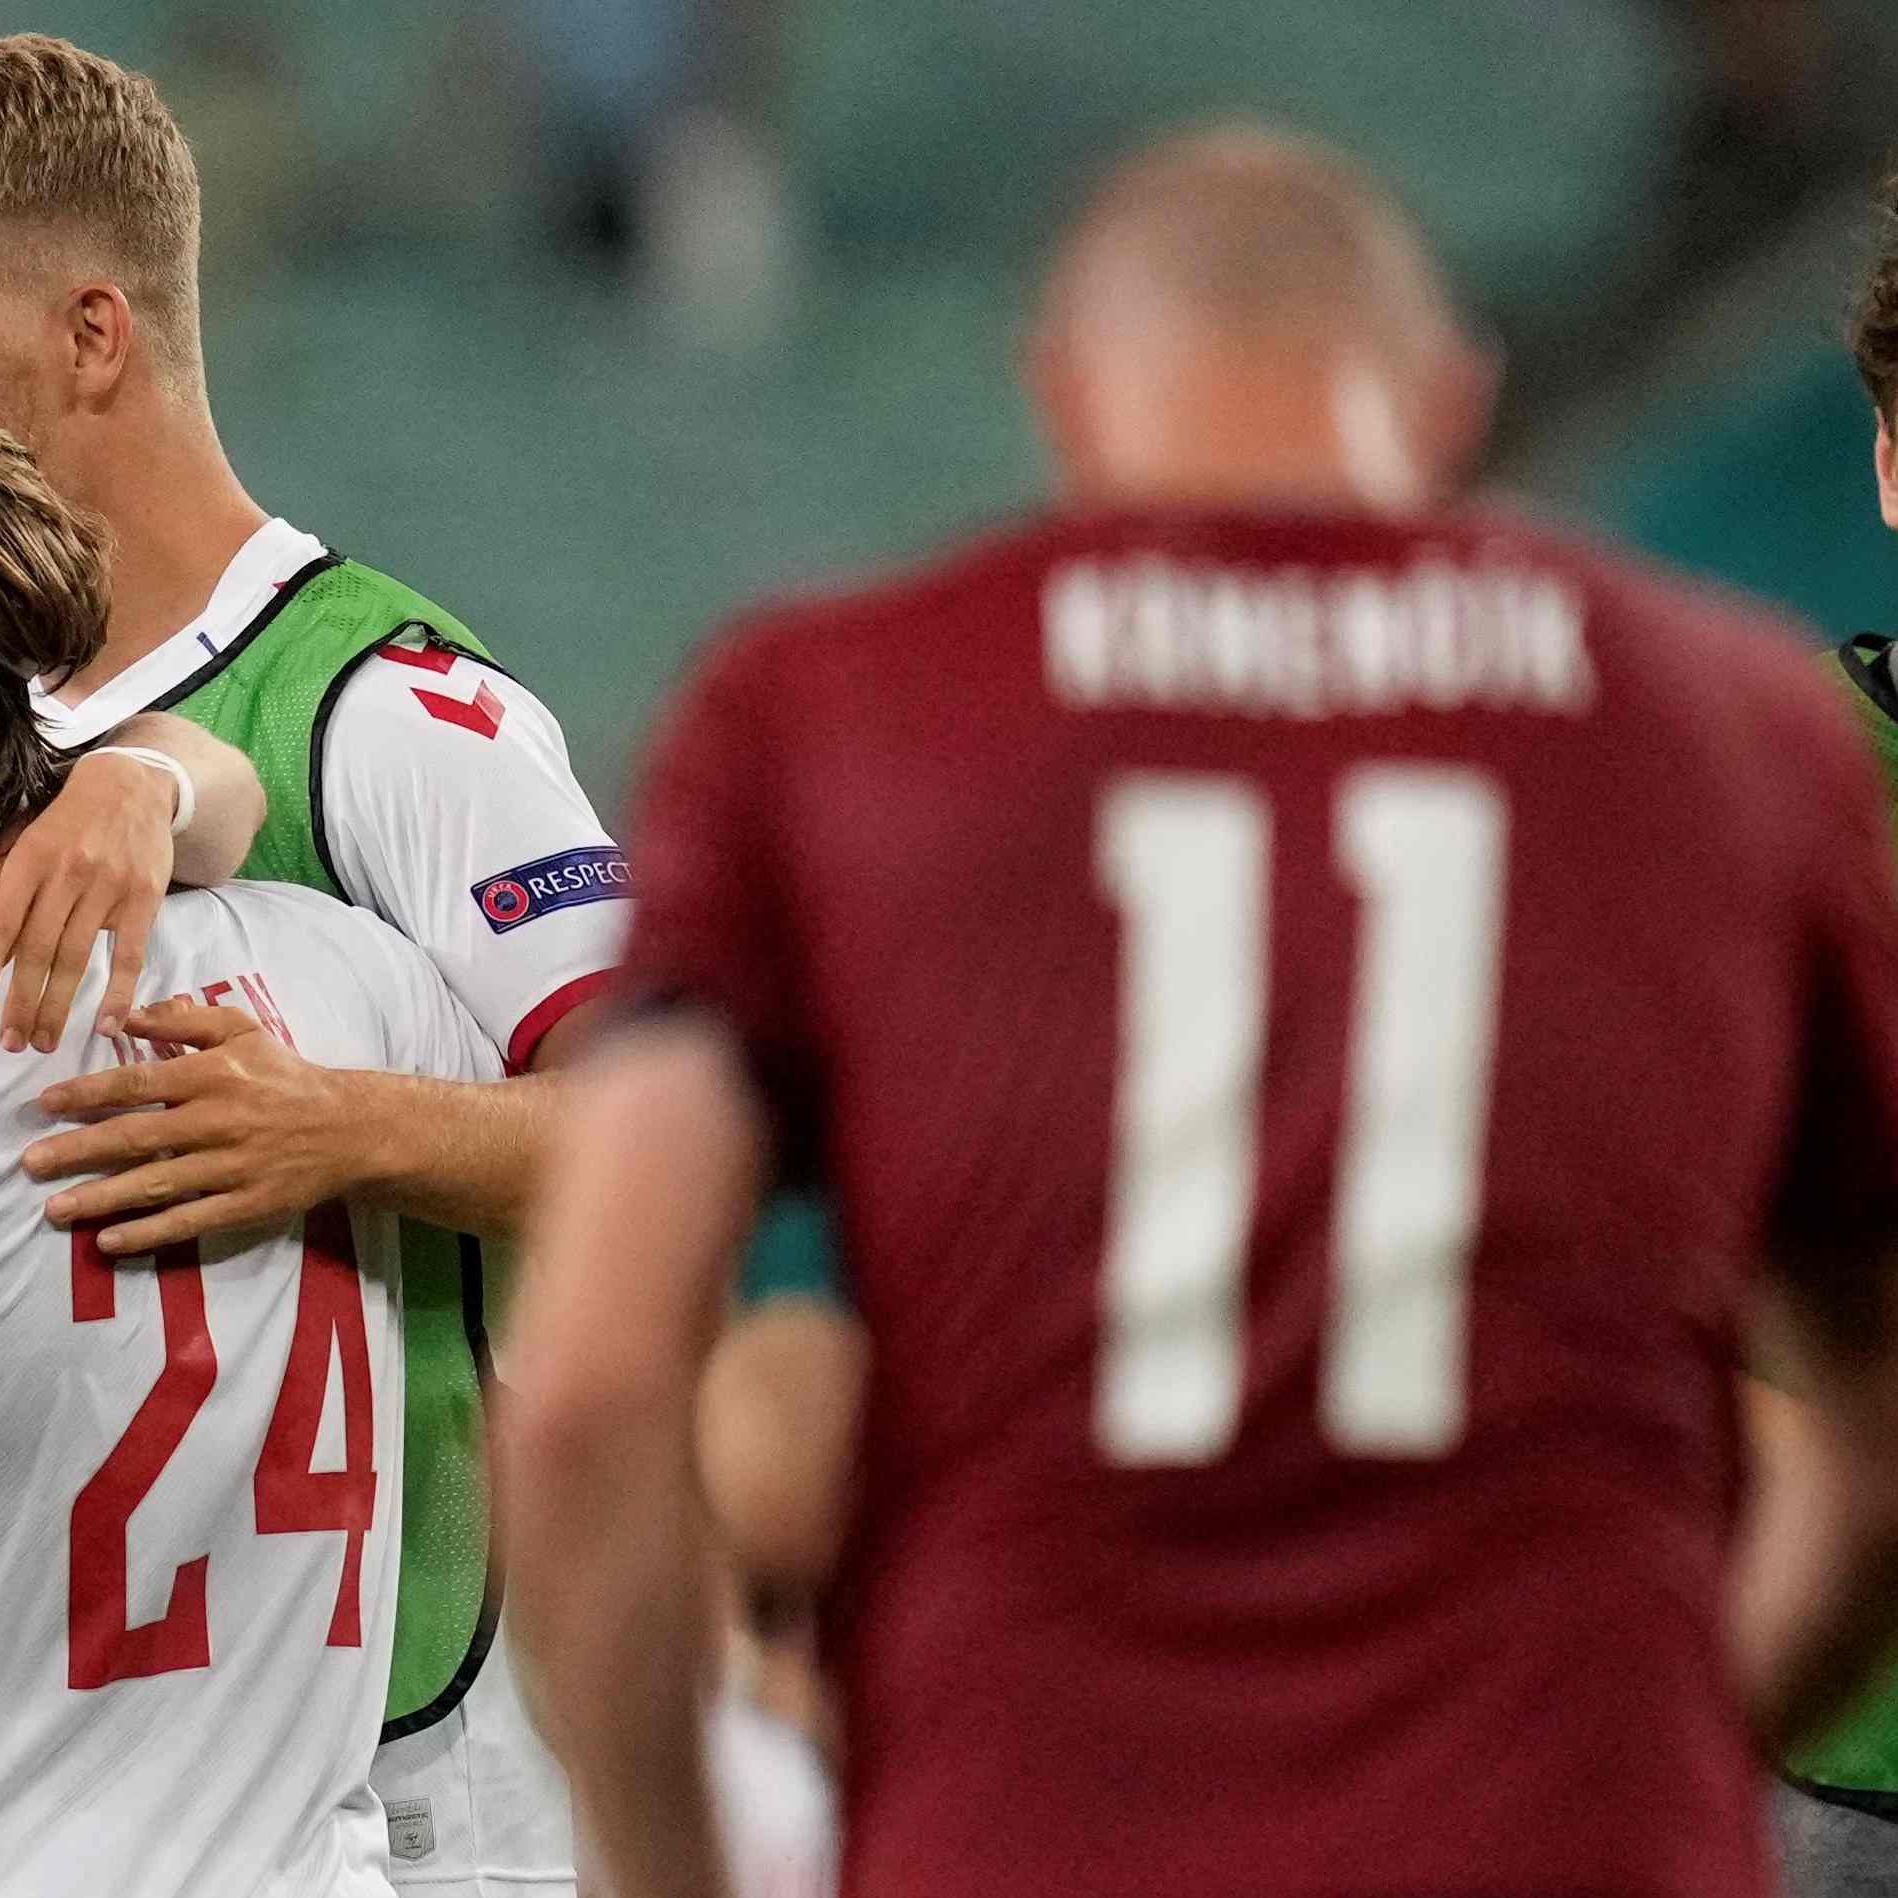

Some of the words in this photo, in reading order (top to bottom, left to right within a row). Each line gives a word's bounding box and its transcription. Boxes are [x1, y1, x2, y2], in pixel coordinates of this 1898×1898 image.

[528, 862, 634, 899] RESPECT
[1096, 762, 1508, 1469] 11
[67, 1202, 377, 1690] 24
